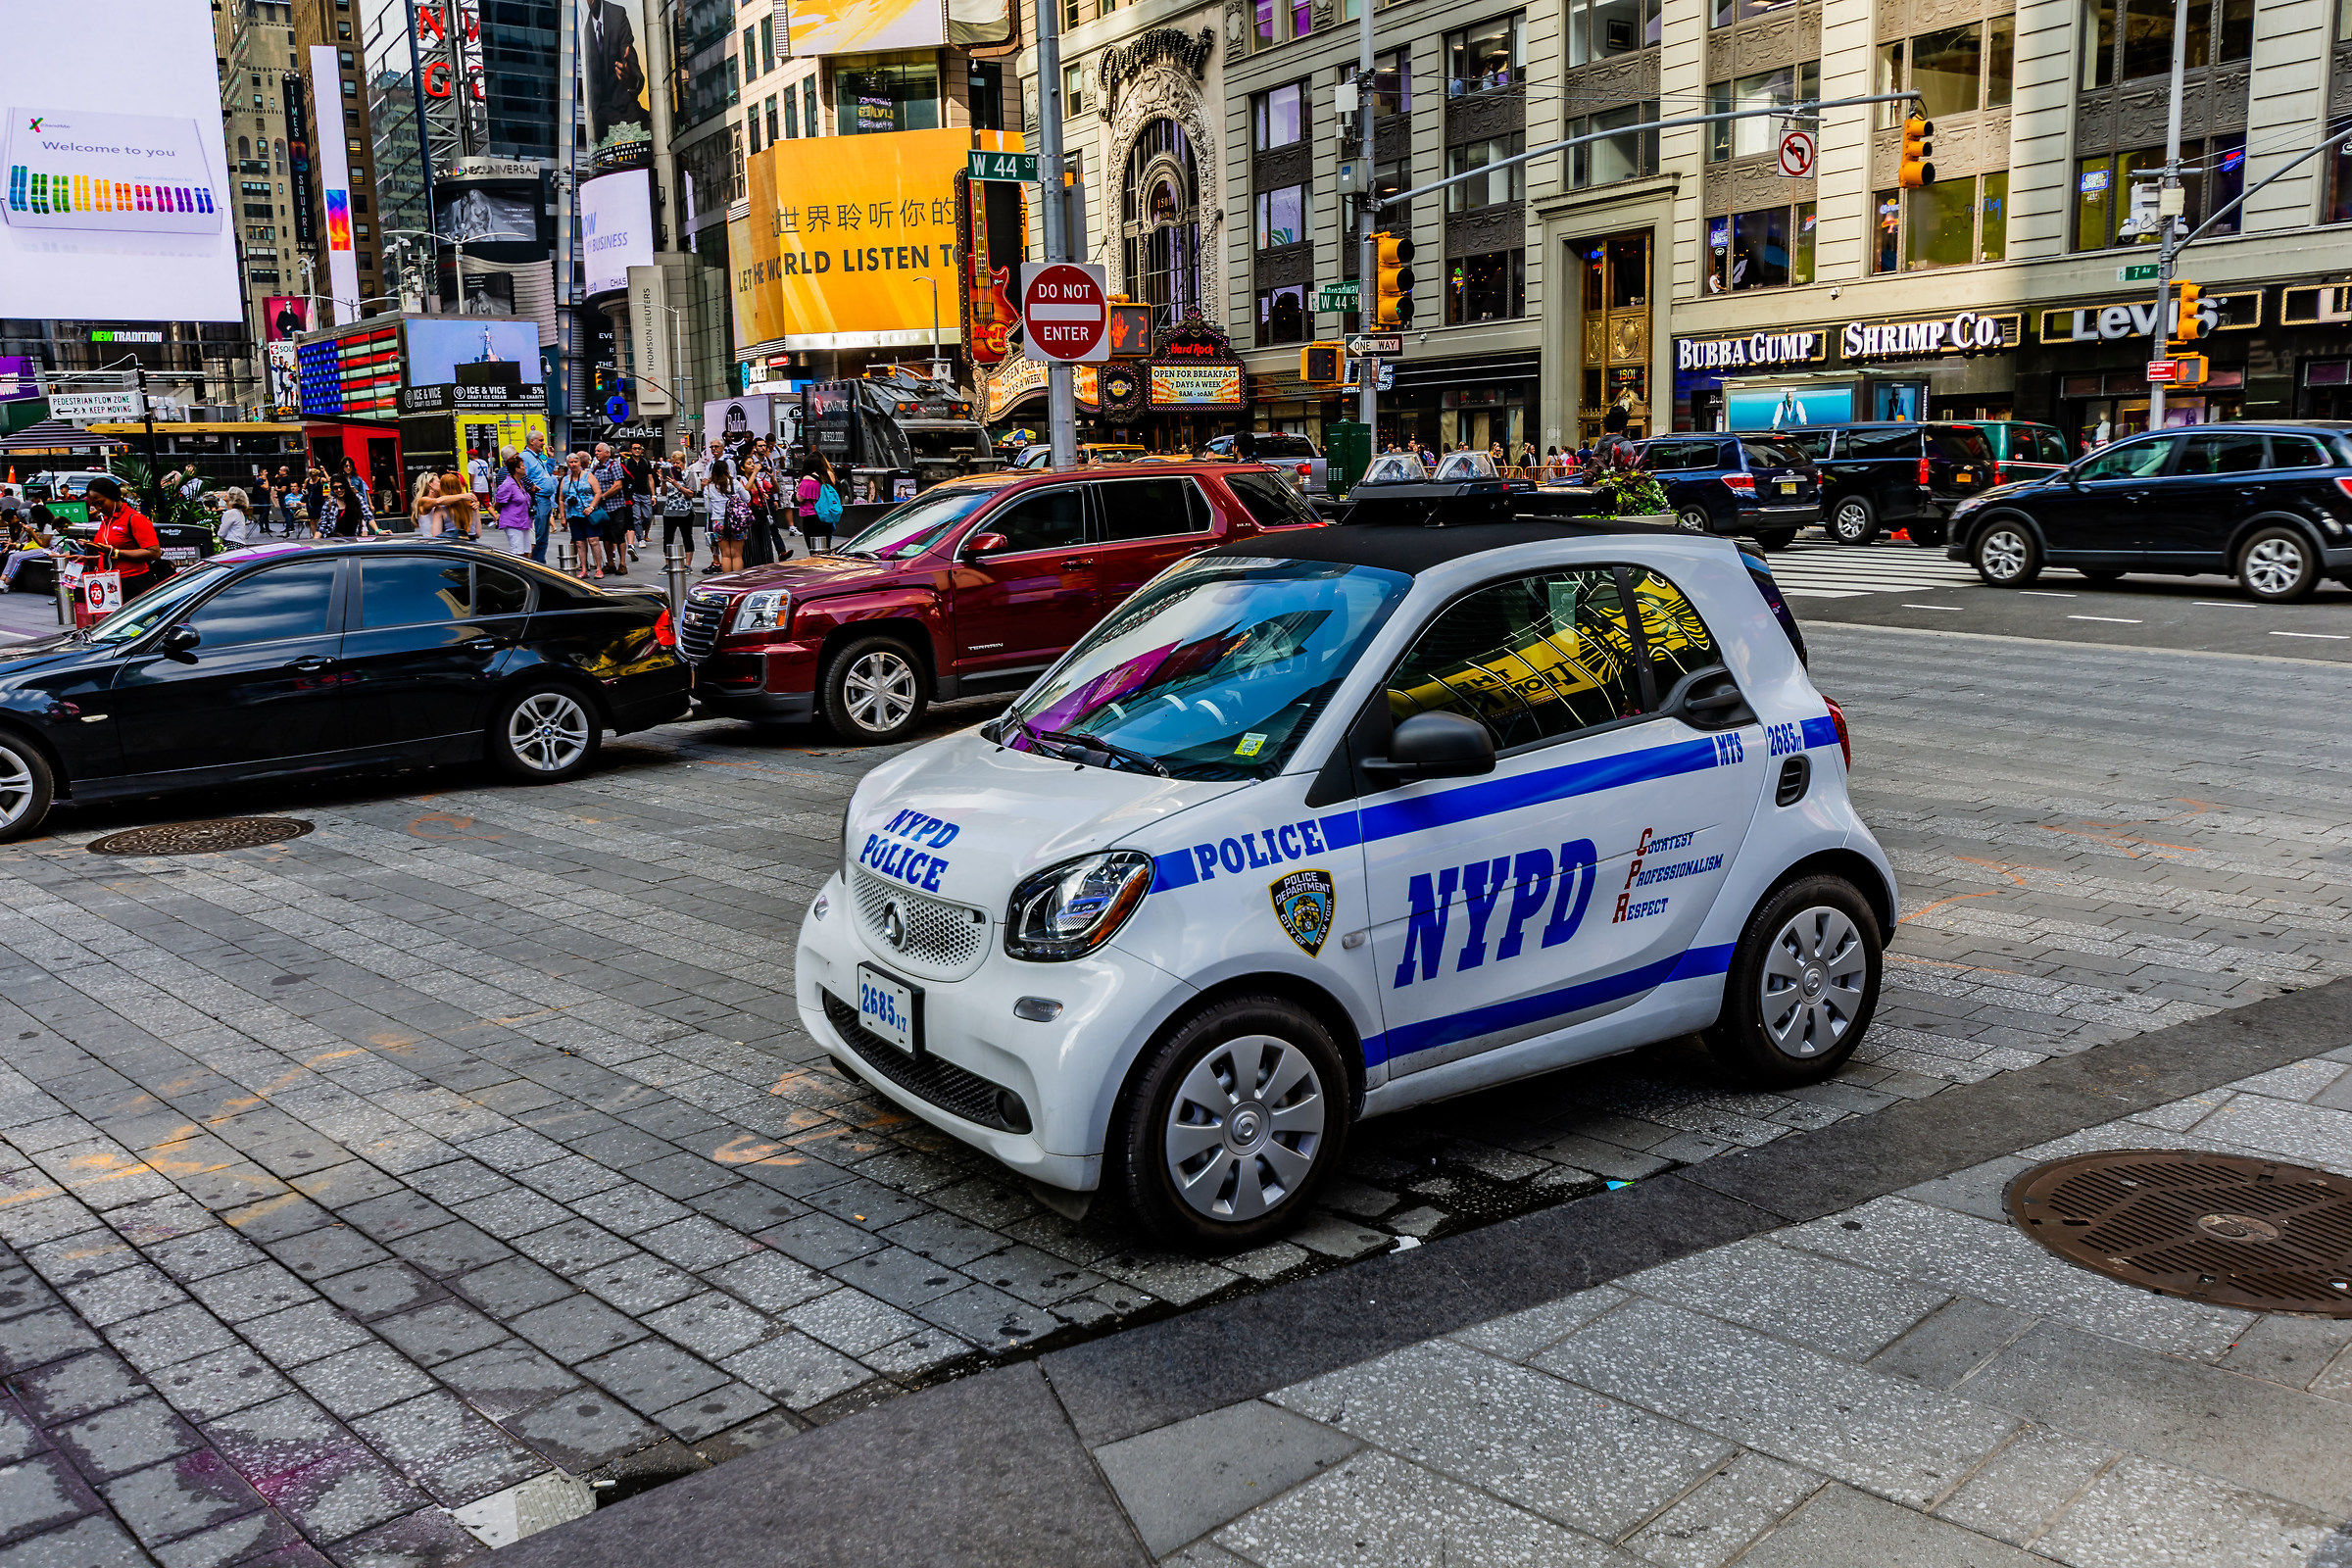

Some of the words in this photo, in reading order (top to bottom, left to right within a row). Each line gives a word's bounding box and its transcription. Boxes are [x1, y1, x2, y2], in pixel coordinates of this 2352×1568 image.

[290, 84, 300, 137] TIMES
[42, 140, 121, 154] Welcome
[125, 146, 141, 156] to
[146, 148, 176, 159] you
[972, 154, 987, 176] W
[994, 156, 1018, 177] 44
[1024, 157, 1035, 169] ST
[298, 174, 308, 237] SQUARE
[592, 232, 628, 253] BUSINESS
[738, 269, 753, 293] LET
[843, 245, 929, 272] LISTEN
[2134, 267, 2140, 278] 7
[1038, 283, 1057, 299] DO
[1063, 283, 1091, 299] NOT
[643, 287, 652, 327] REUTERS
[1320, 295, 1331, 310] W
[1334, 295, 1348, 310] 44
[1350, 296, 1358, 305] St
[1043, 326, 1089, 341] ENTER
[646, 328, 655, 372] THOMSON
[1170, 342, 1194, 355] Hard
[1193, 343, 1215, 357] Rock
[1354, 341, 1371, 351] ONE
[1378, 340, 1396, 351] WAY
[1679, 338, 1746, 369] BUBBA
[1749, 331, 1813, 364] GUMP
[1844, 321, 1945, 357] SHRIMP
[1001, 363, 1020, 387] OPEN
[1020, 360, 1035, 372] FOR
[1024, 373, 1042, 386] WEEK
[1153, 369, 1175, 378] OPEN
[1176, 369, 1193, 378] FOR
[1193, 369, 1237, 378] BREAKFAST
[1618, 368, 1637, 381] 1501
[52, 396, 93, 406] PEDESTRIAN
[94, 396, 112, 405] FLOW
[113, 395, 130, 404] ZONE
[413, 388, 423, 401] ICE
[428, 386, 442, 399] VICE
[466, 386, 480, 395] ICE
[481, 386, 488, 395] &
[488, 386, 507, 395] VICE
[531, 386, 544, 395] 5%
[89, 406, 106, 415] KEEP
[107, 405, 132, 414] MOVING
[618, 427, 662, 438] CHASE
[90, 589, 102, 601] $29
[967, 642, 1004, 651] TERRAIN
[1715, 731, 1744, 766] MTS
[1767, 722, 1797, 757] 2685
[883, 808, 960, 849] NYPD
[1193, 819, 1326, 882] POLICE
[859, 833, 950, 893] POLICE
[1283, 871, 1318, 889] POLICE
[1275, 882, 1331, 906] DEPARTMENT
[1393, 838, 1598, 989] NYPD
[1611, 892, 1669, 924] RESPECT
[1280, 913, 1297, 935] CITY
[1295, 934, 1306, 946] OF
[1315, 923, 1328, 945] NEW
[1324, 898, 1333, 922] YORK
[861, 983, 896, 1026] 2685
[896, 1013, 906, 1033] 17
